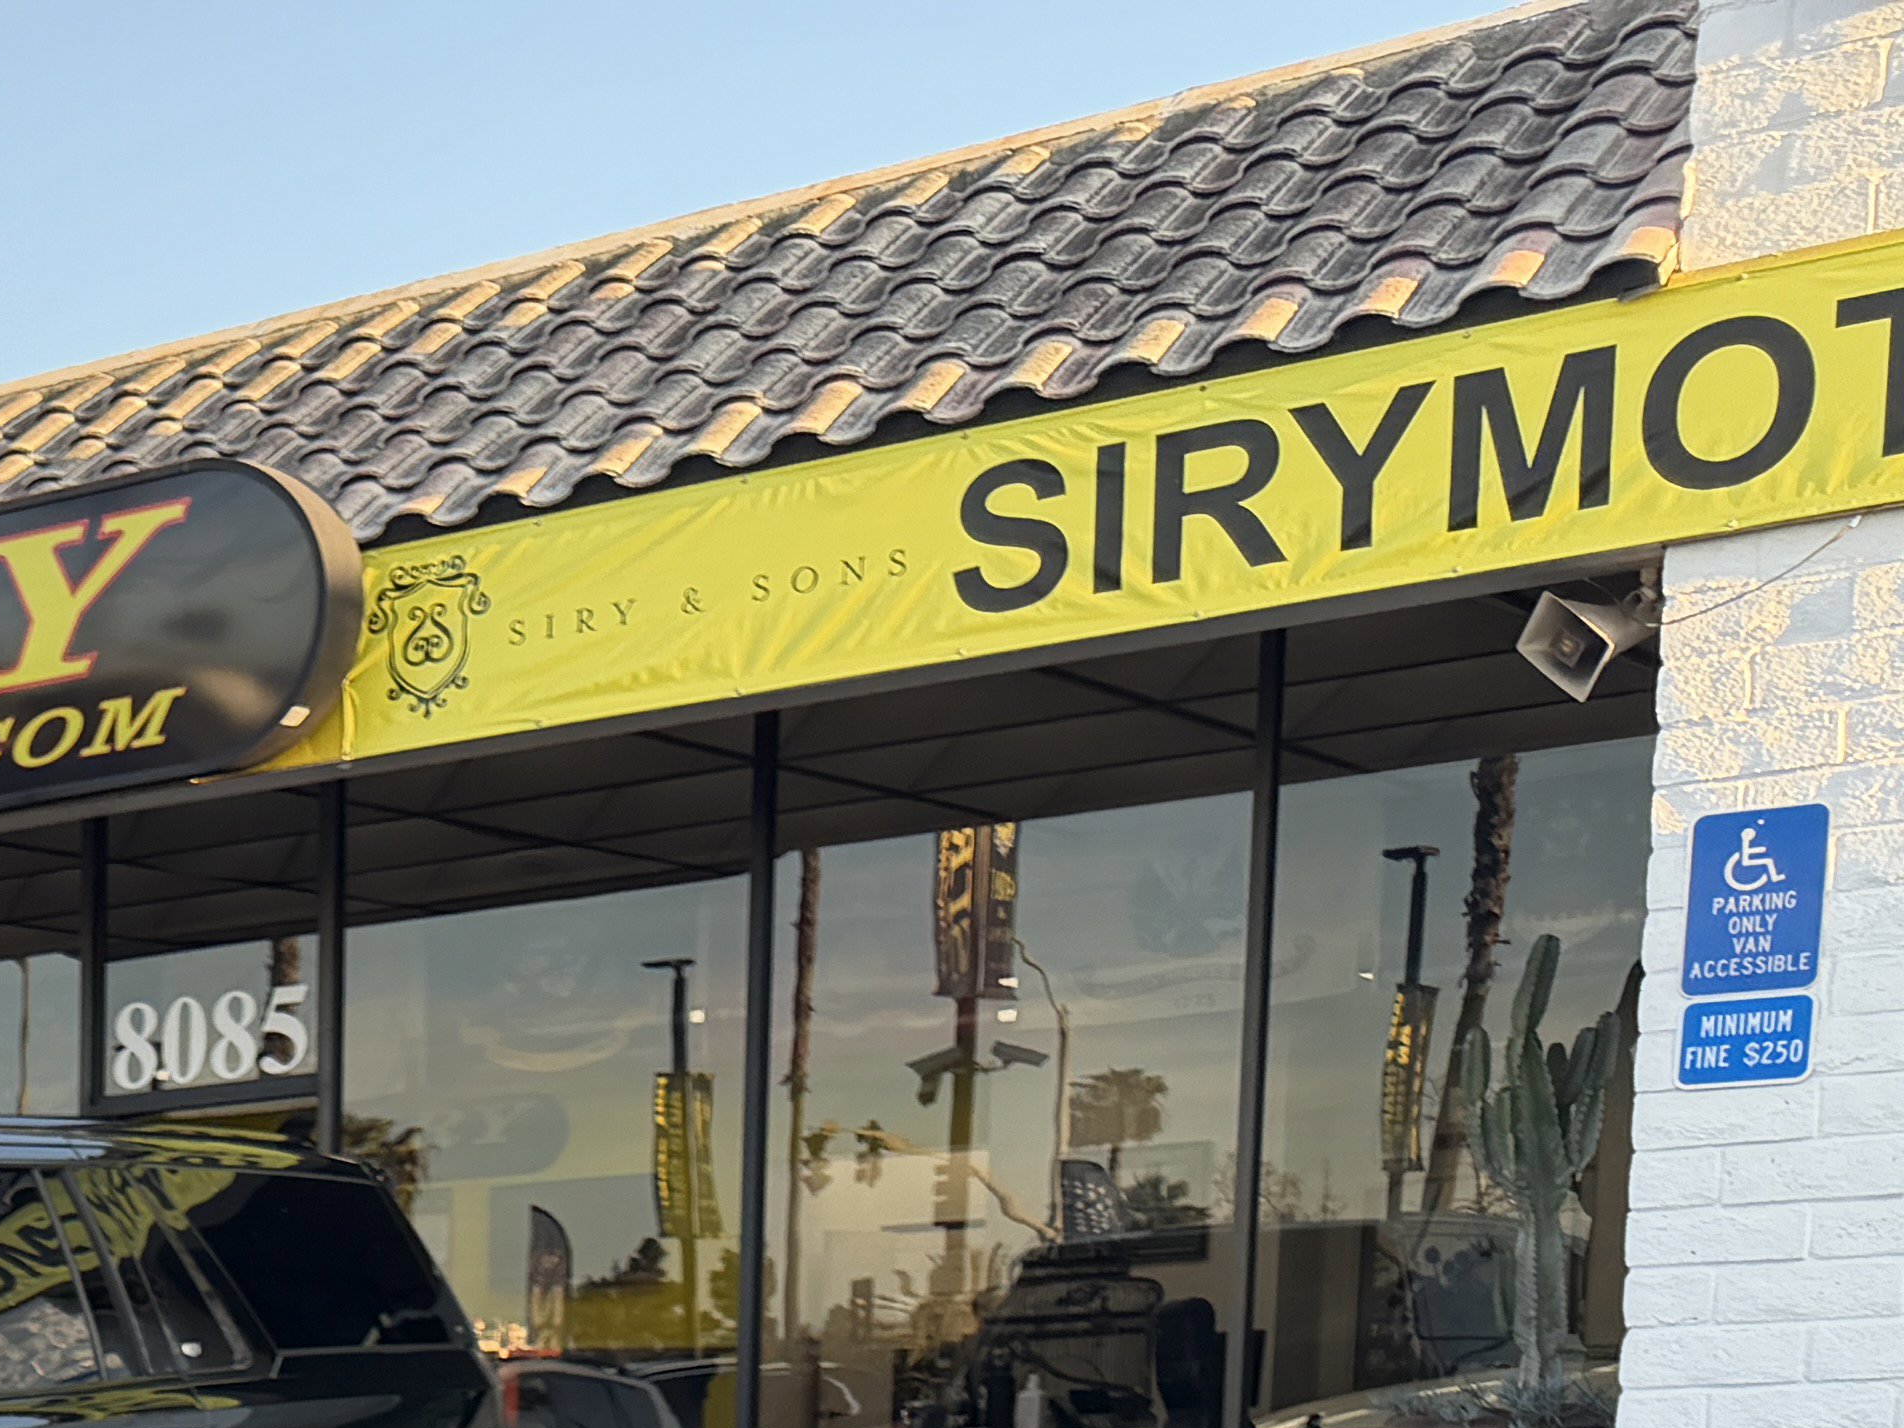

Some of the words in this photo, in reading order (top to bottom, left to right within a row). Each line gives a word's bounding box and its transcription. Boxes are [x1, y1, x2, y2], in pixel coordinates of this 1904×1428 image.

[507, 598, 638, 647] SIRY
[679, 586, 706, 615] &
[750, 548, 910, 603] SONS
[1713, 891, 1797, 915] PARKING
[1727, 913, 1778, 935] ONLY
[1732, 936, 1772, 954] VAN
[1689, 952, 1811, 979] ACCESSIBLE
[1700, 1010, 1793, 1038] MINIMUM
[112, 984, 309, 1094] 8085
[1684, 1045, 1730, 1070] FINE
[1743, 1040, 1804, 1067] $250
